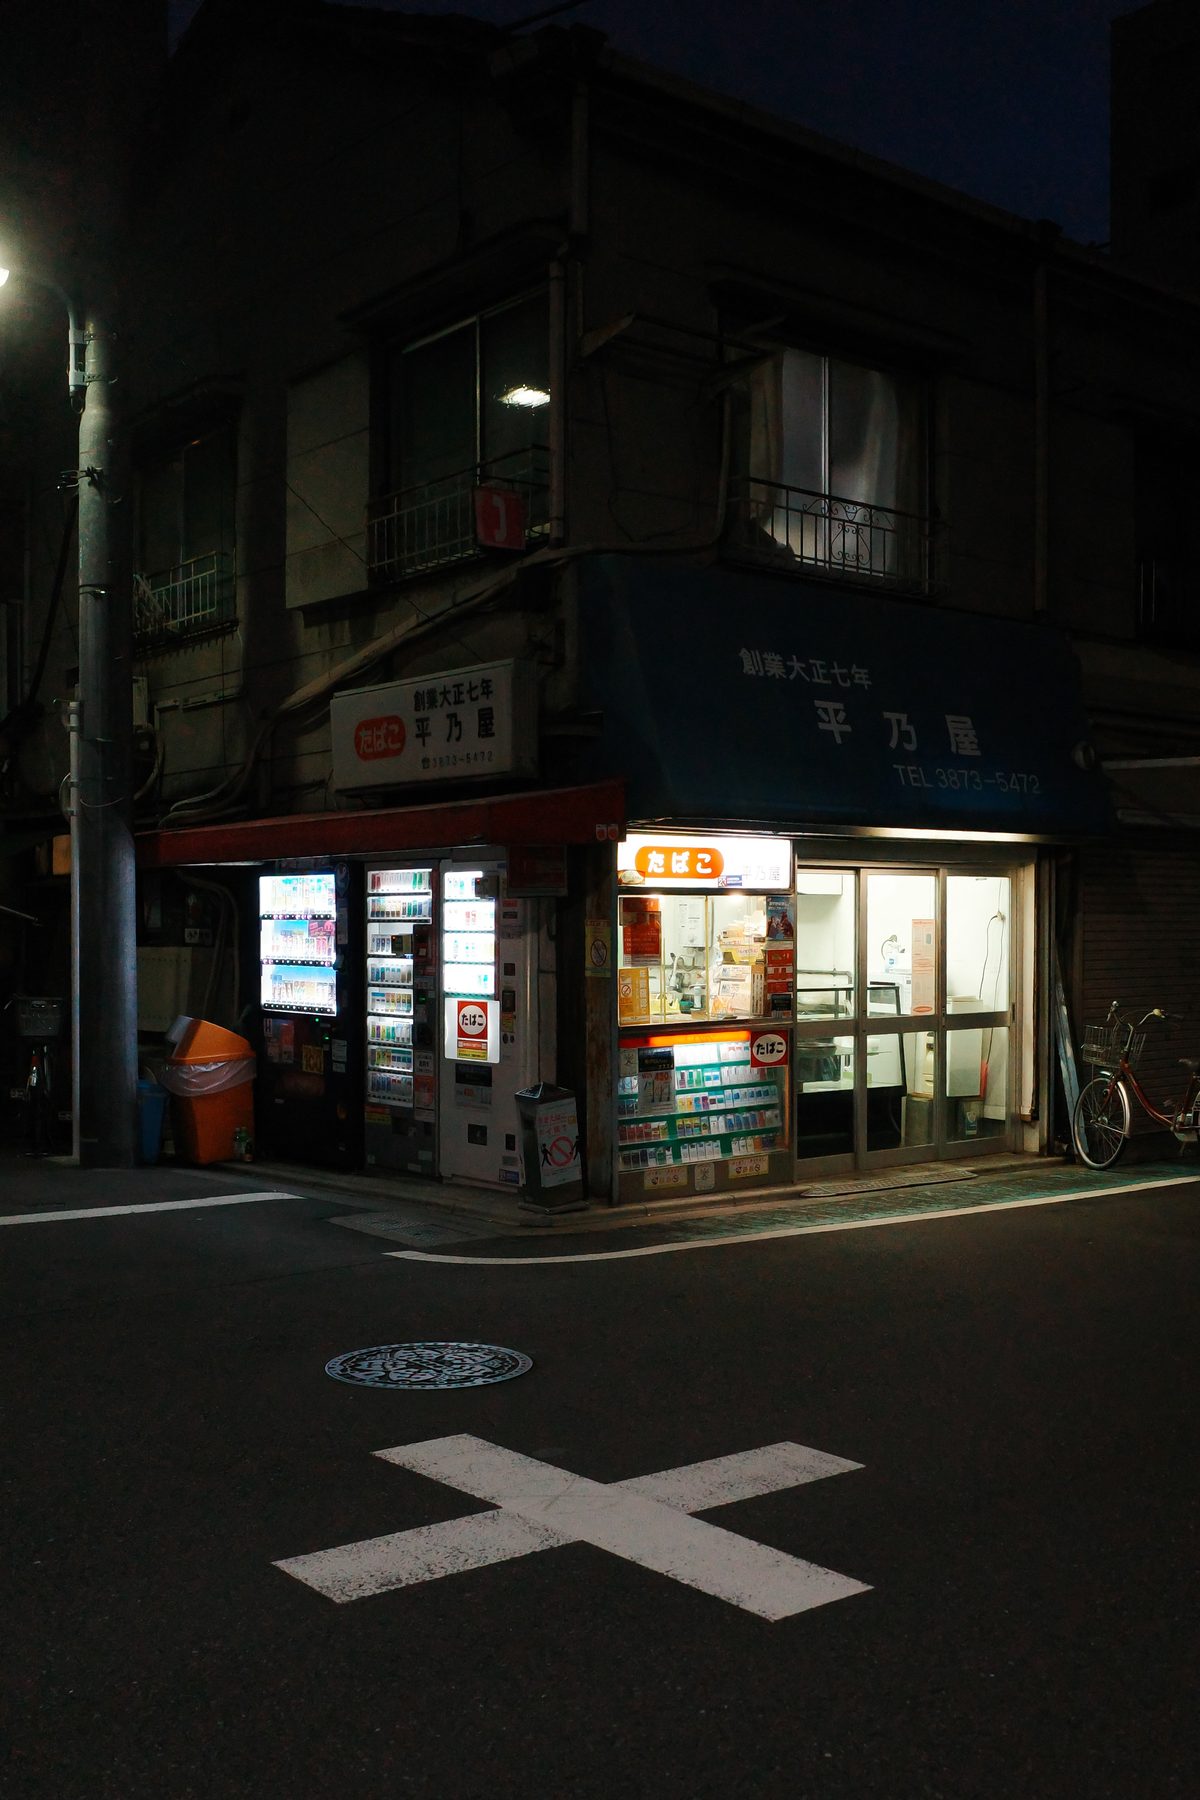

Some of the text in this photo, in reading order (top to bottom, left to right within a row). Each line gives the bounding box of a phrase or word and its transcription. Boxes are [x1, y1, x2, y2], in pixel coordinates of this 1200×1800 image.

[738, 647, 873, 690] 創業大正七年
[413, 678, 494, 712] 創業大正七年
[358, 720, 403, 755] たばこ
[414, 706, 496, 748] 平乃屋
[813, 699, 983, 757] 平乃屋
[892, 763, 1041, 795] TEL 3873-5472
[646, 849, 714, 874] たばこ
[460, 1011, 484, 1028] たばこ
[755, 1041, 784, 1057] たばこ
